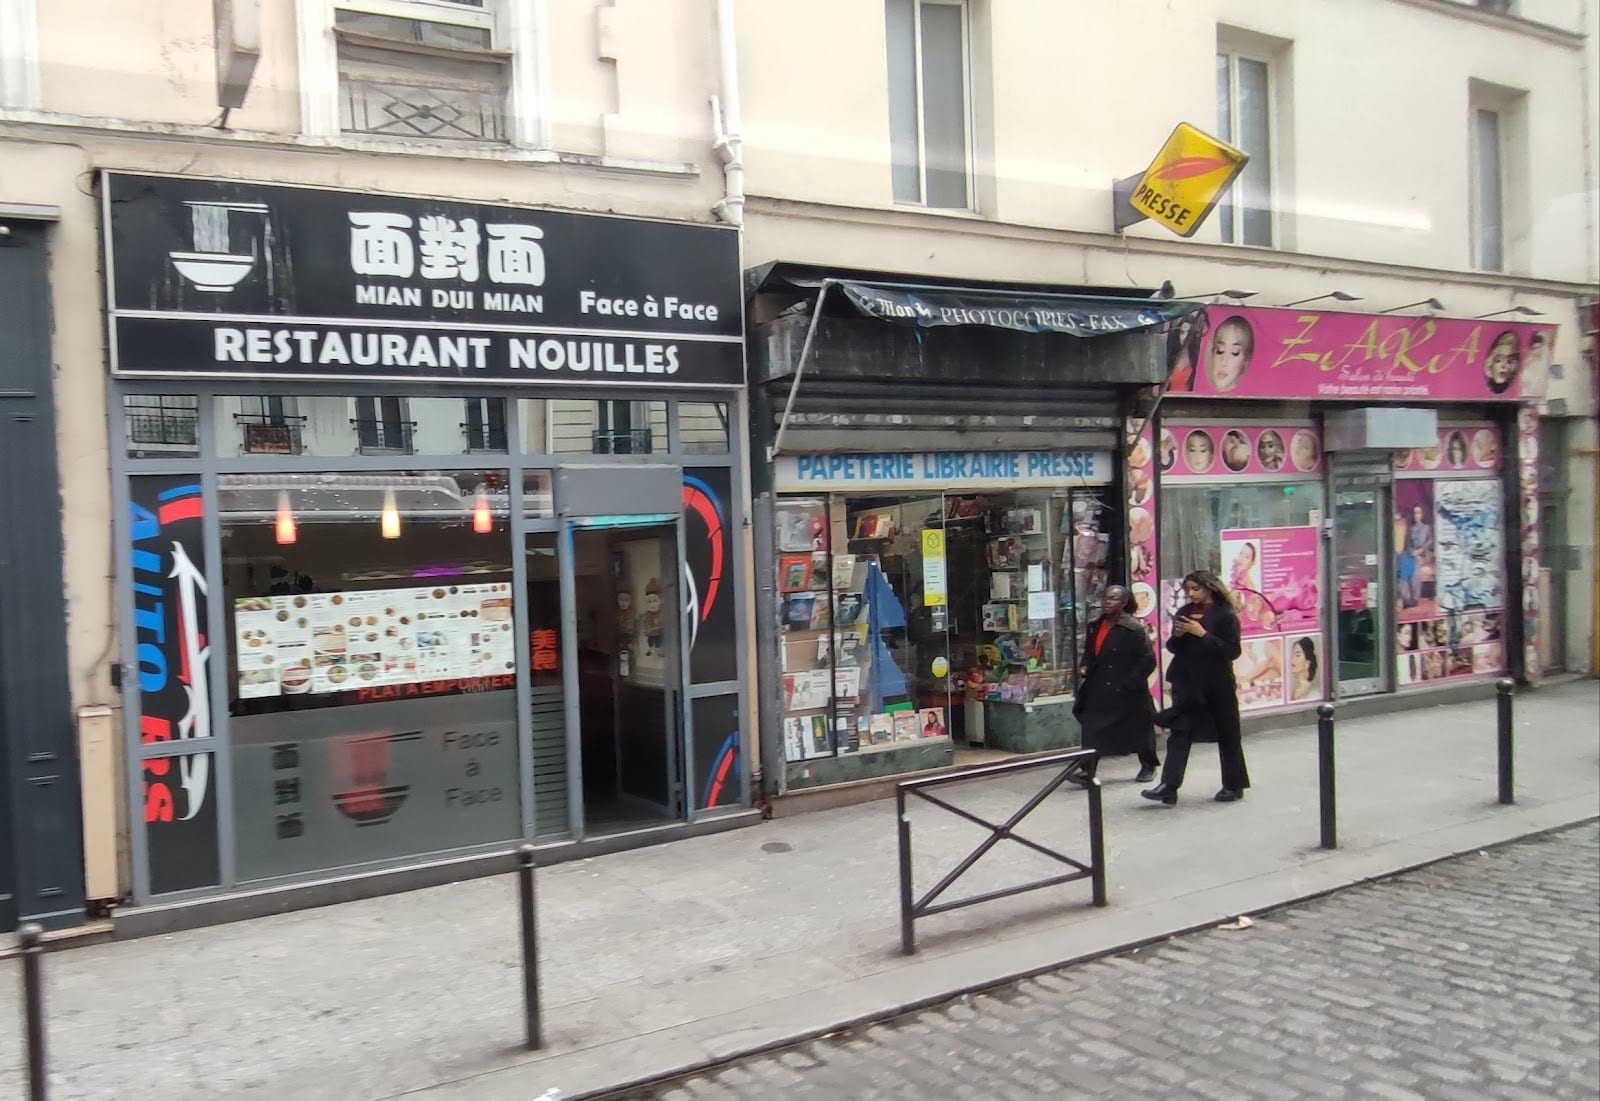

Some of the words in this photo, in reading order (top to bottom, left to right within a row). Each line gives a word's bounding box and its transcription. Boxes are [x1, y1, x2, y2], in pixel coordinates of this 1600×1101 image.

[1135, 183, 1191, 226] PRESSE
[348, 211, 546, 287] 面對面
[355, 284, 422, 308] MIAN
[431, 288, 474, 310] DUI
[483, 292, 544, 314] MIAN
[579, 290, 638, 317] Face
[643, 295, 659, 319] à
[663, 296, 719, 322] Face
[213, 327, 491, 369] RESTAURANT
[508, 338, 679, 375] NOUILLES
[1271, 315, 1482, 375] ZARA
[797, 453, 914, 481] PAPETERIE
[923, 451, 1019, 480] LIBRAIRIE
[1027, 450, 1094, 478] PRESSE
[444, 731, 500, 751] Face
[446, 787, 502, 808] Face
